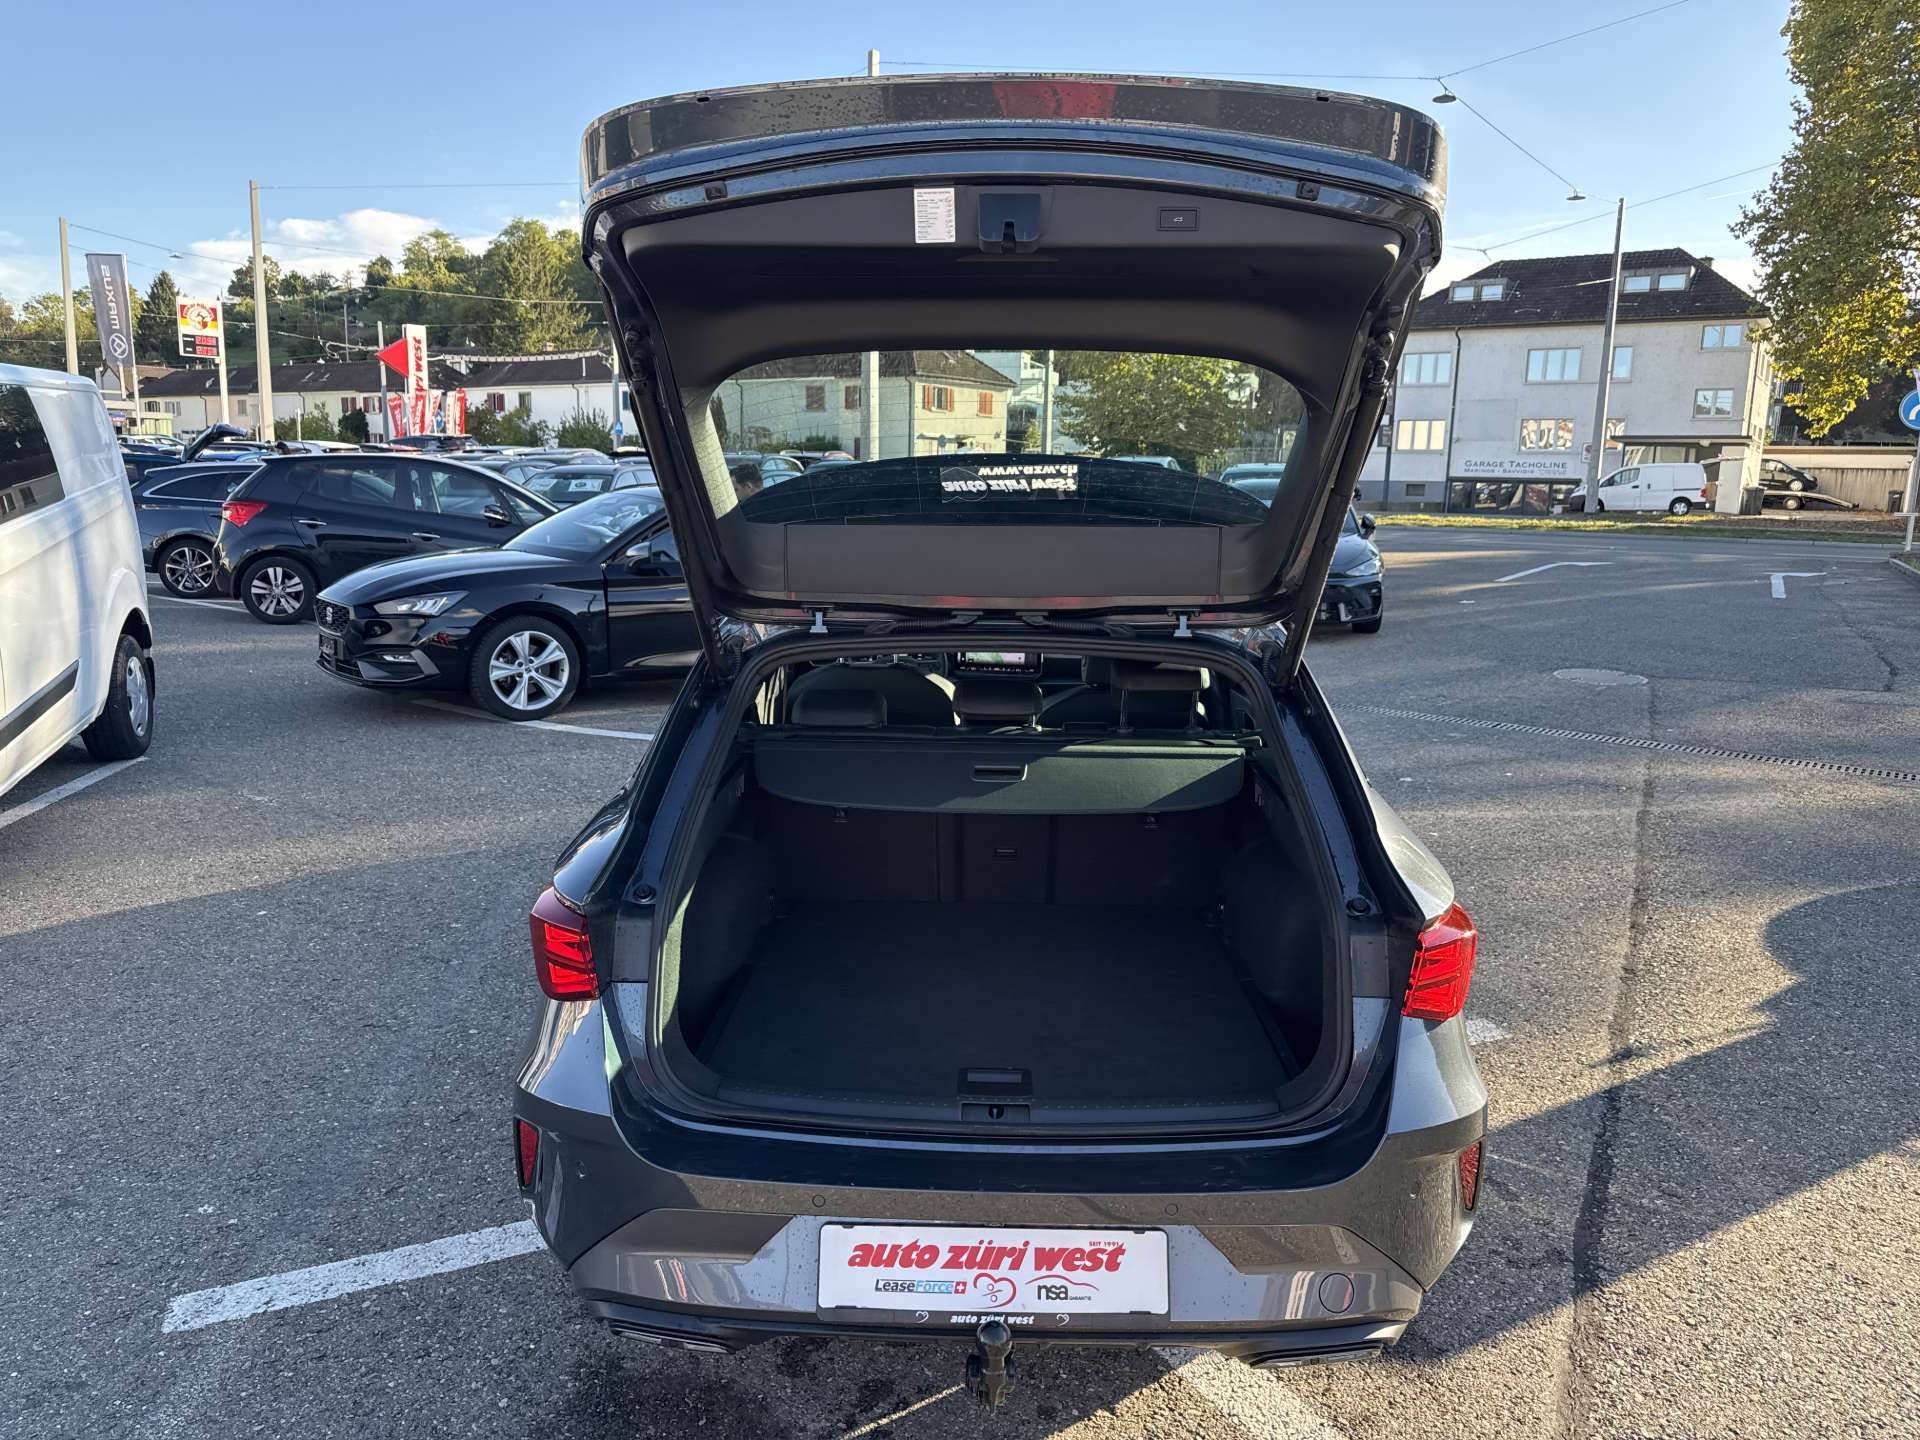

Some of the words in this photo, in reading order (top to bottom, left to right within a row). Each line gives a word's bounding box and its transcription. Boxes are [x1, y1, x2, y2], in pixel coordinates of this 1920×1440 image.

[1464, 460, 1505, 468] GARAGE
[1508, 460, 1568, 469] TACHOLINE
[848, 1239, 940, 1269] auto
[941, 1240, 1030, 1271] züri
[1034, 1242, 1126, 1272] west
[875, 1279, 954, 1293] LeaseForce
[1037, 1285, 1069, 1301] nsa
[950, 1314, 978, 1324] auto
[1008, 1315, 1035, 1325] west
